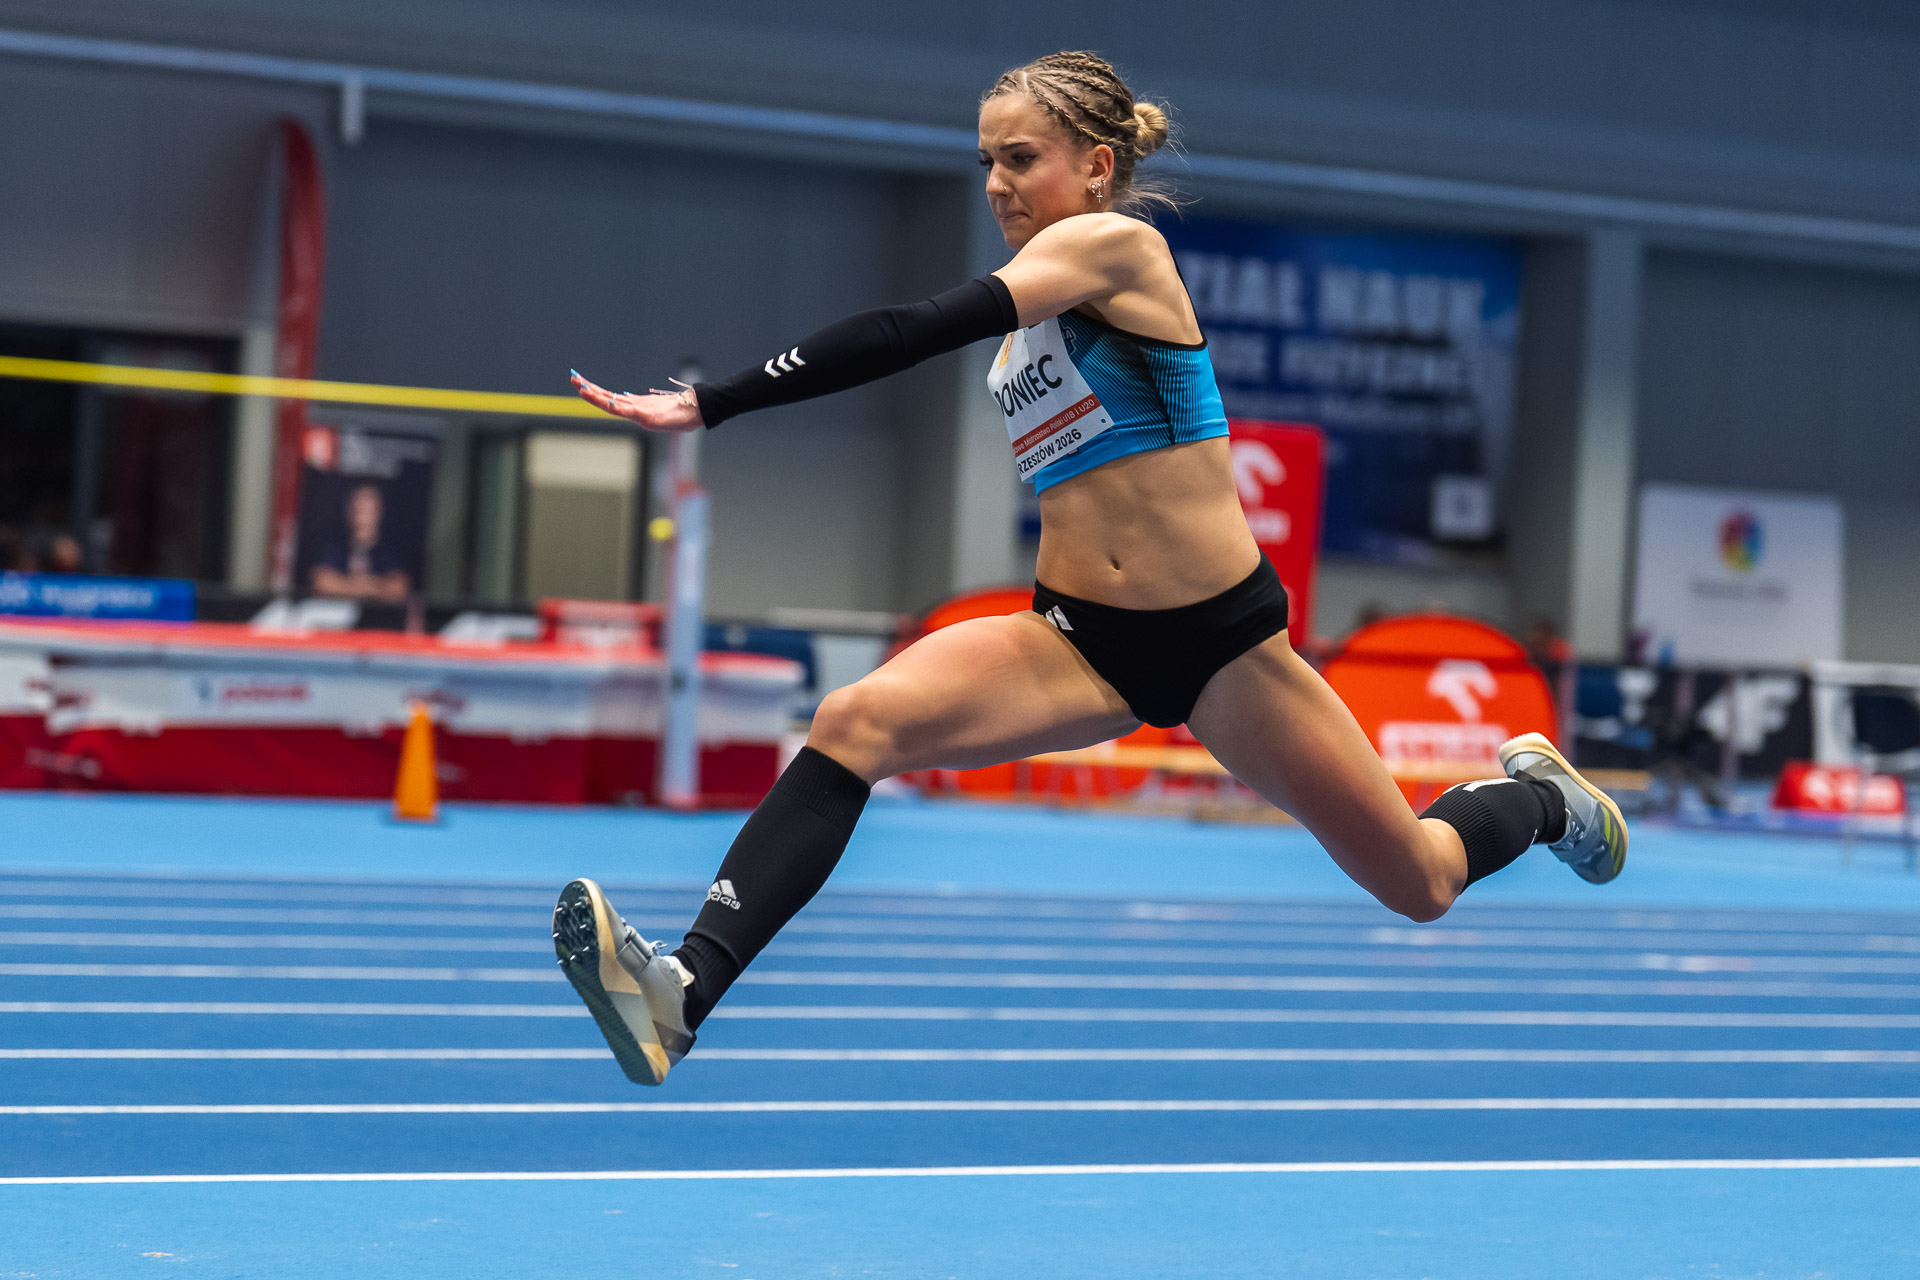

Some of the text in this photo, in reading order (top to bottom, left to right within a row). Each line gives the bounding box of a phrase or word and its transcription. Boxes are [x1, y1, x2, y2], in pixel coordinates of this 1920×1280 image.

[1062, 410, 1076, 424] U18
[1078, 399, 1095, 413] U20
[1017, 428, 1082, 475] RZESZÓW 2026
